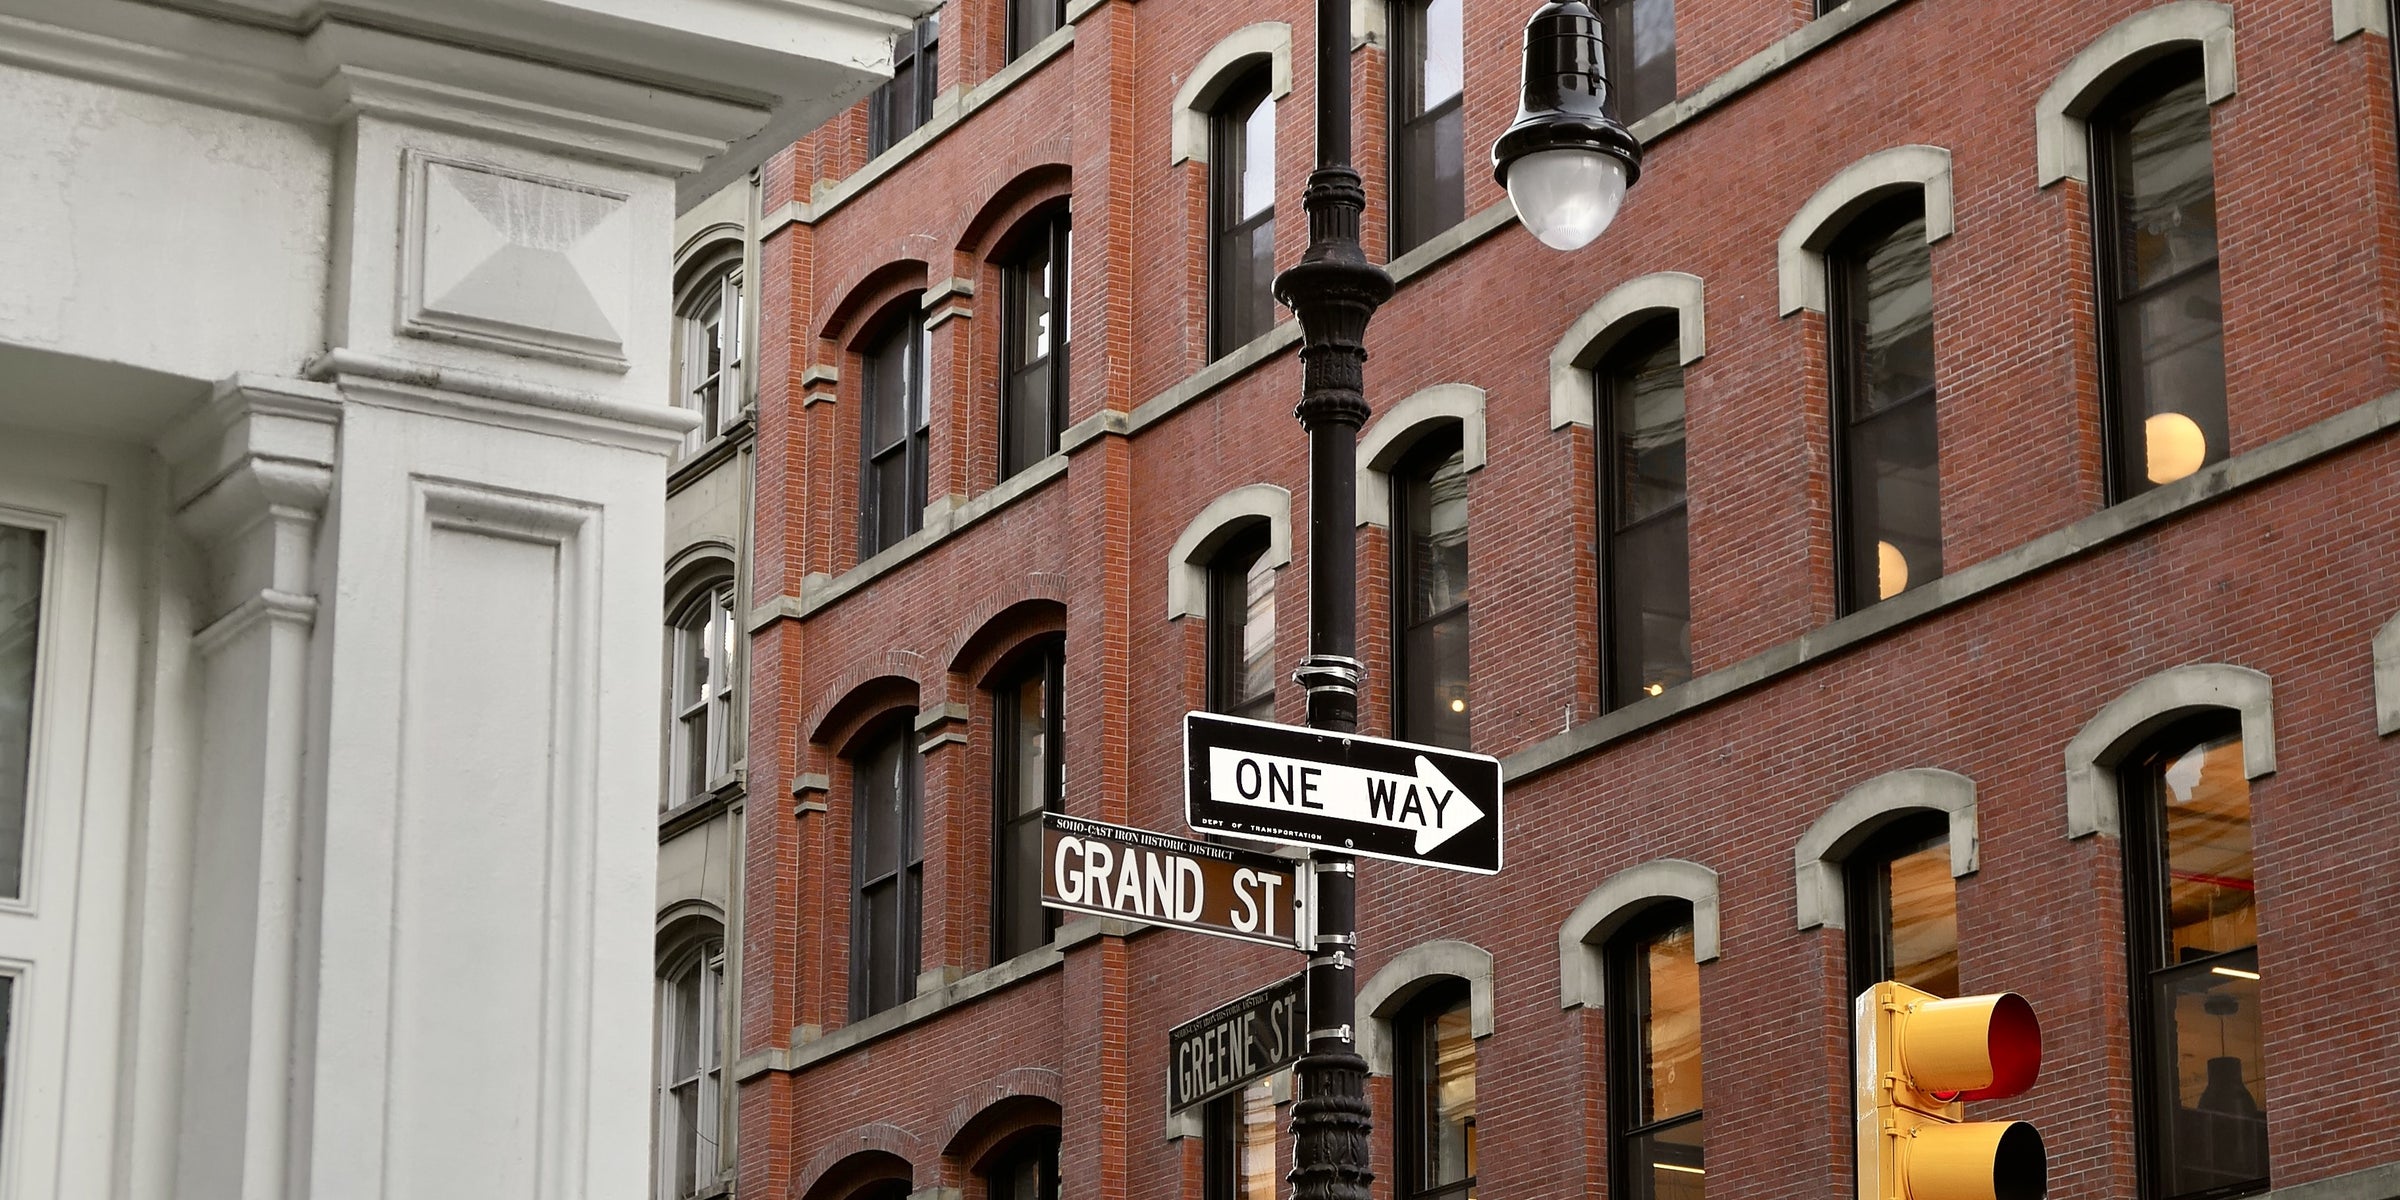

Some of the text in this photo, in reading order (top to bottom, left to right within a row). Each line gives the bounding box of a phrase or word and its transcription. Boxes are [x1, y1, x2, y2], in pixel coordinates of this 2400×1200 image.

[1236, 758, 1454, 829] ONE WAY
[1056, 818, 1234, 861] SOHO-CAST IRON HISTORIC DISTRICT
[1202, 818, 1224, 827] DEPT
[1250, 825, 1322, 841] TRANSPORTATION
[1054, 836, 1282, 937] GRAND ST
[1179, 993, 1296, 1103] GREENE ST
